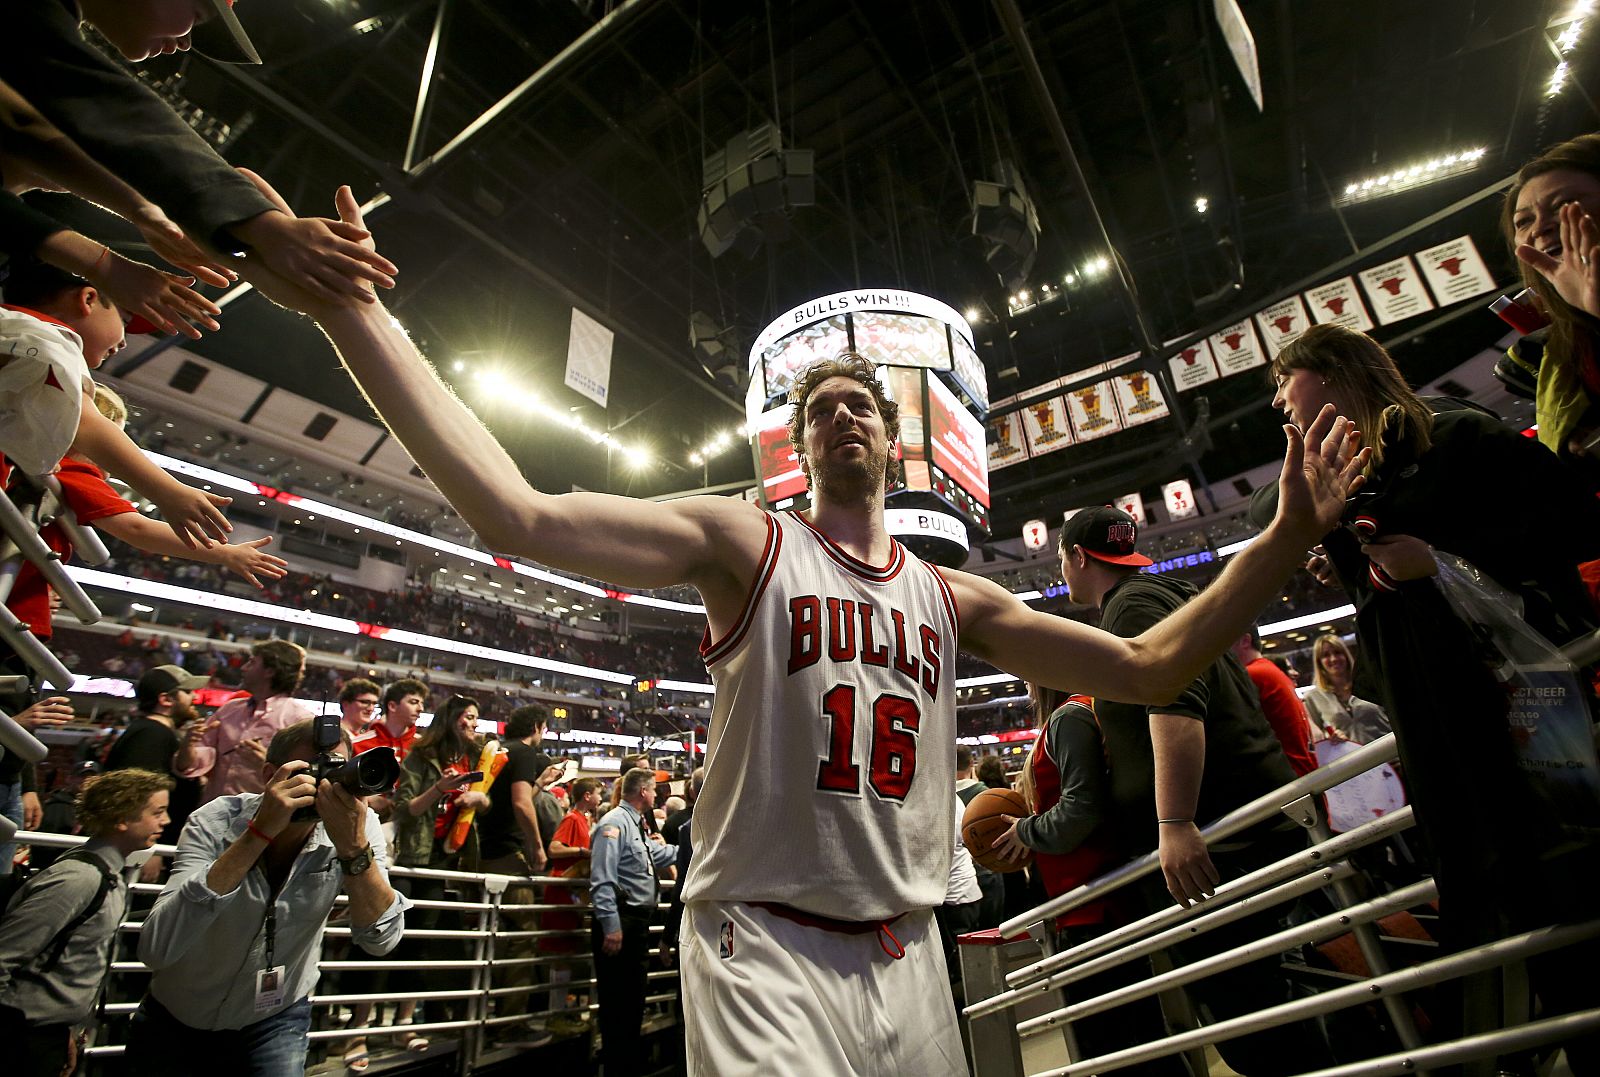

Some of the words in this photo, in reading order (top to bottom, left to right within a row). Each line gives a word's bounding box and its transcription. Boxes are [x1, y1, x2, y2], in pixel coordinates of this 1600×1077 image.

[794, 296, 849, 324] BULLS
[787, 594, 943, 702] BULLS
[1534, 687, 1566, 697] BEER
[816, 682, 921, 801] 16
